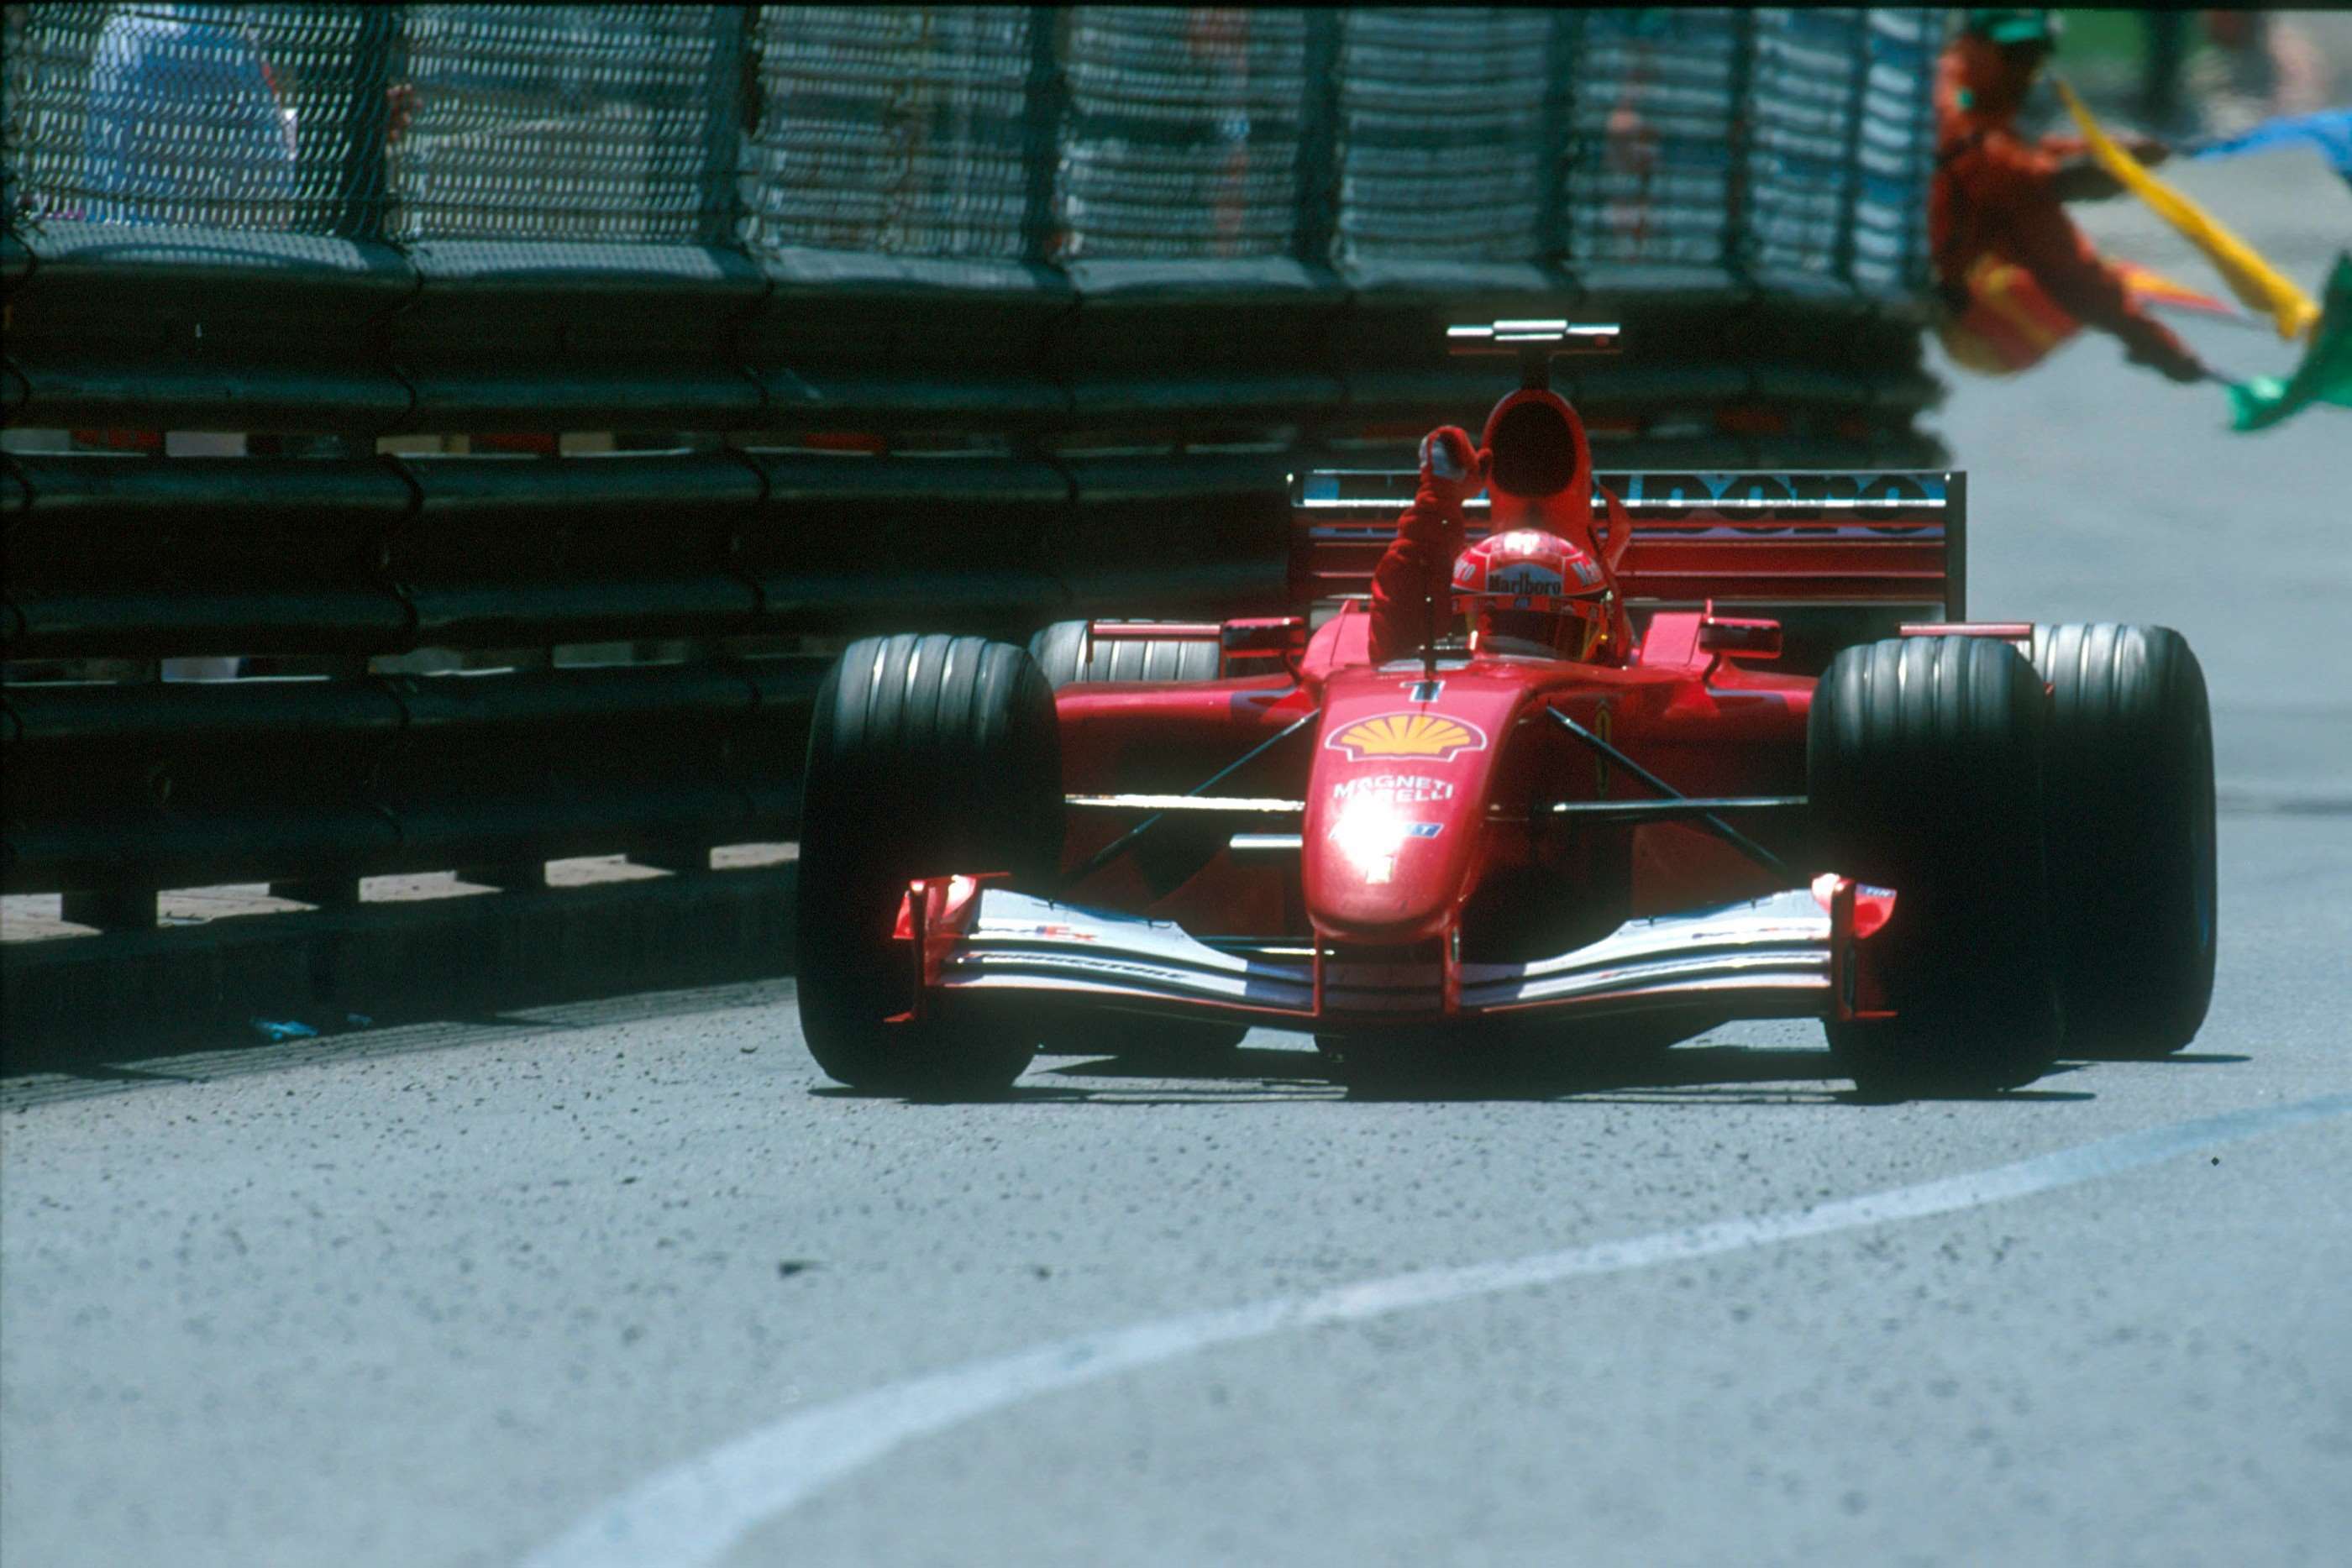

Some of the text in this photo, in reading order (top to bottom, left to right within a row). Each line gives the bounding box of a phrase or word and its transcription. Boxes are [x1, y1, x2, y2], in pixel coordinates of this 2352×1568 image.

[1488, 570, 1562, 595] Marlboro
[1399, 679, 1446, 702] 1
[1333, 774, 1454, 800] MAGNETI
